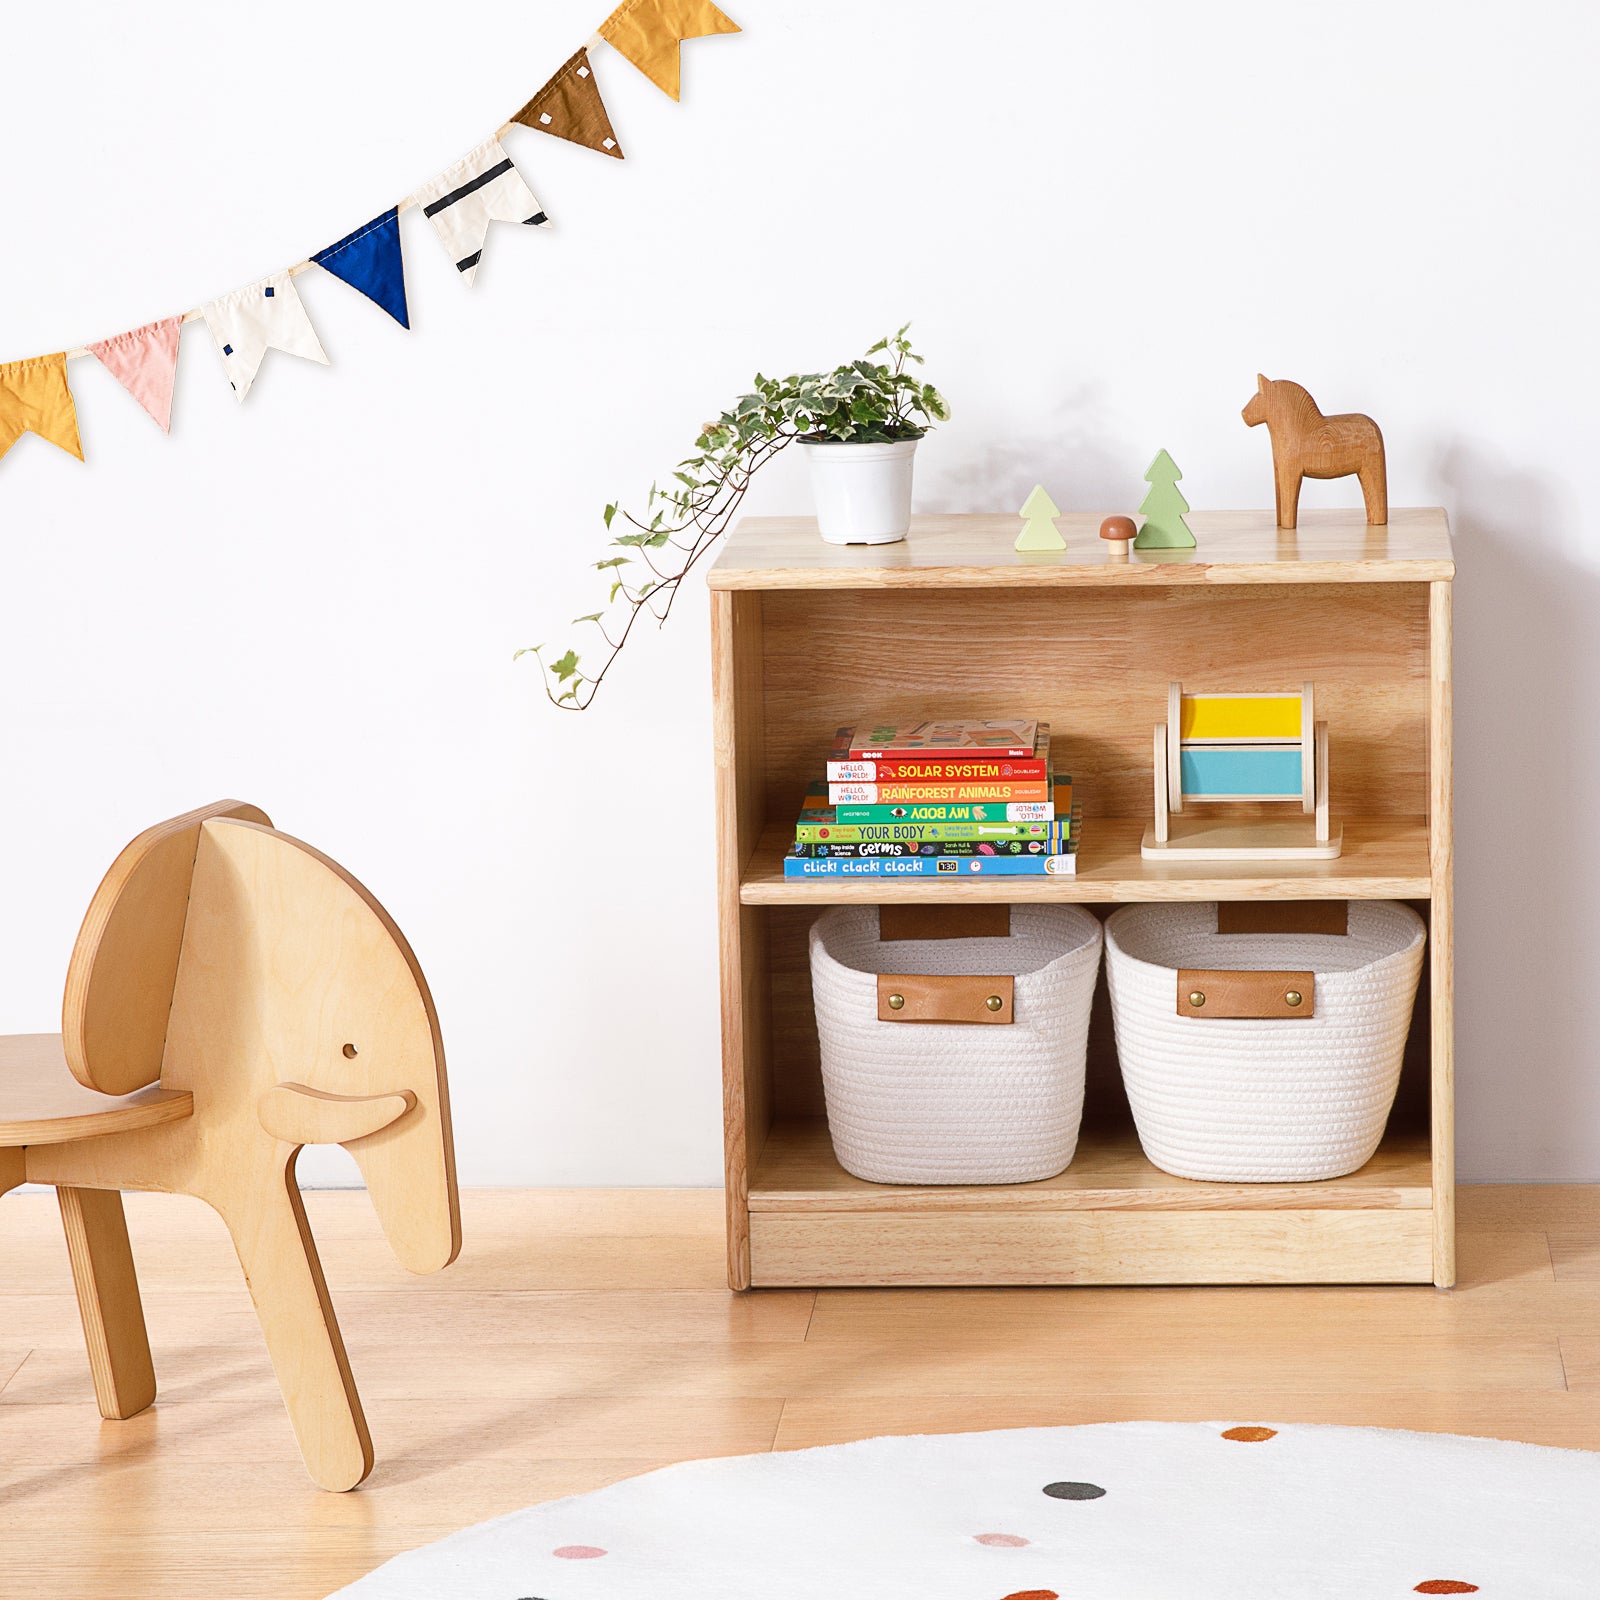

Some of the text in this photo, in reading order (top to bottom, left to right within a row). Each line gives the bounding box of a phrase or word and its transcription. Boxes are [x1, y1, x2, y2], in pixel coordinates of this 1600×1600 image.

[898, 765, 999, 777] SOLAR SYSTEM
[882, 786, 1011, 799] RAINFOREST ANIMALS
[910, 806, 969, 819] MY BODY
[858, 825, 925, 839] YOUR BODY
[859, 843, 903, 856] Germs
[803, 859, 923, 873] click! clack! clock!
